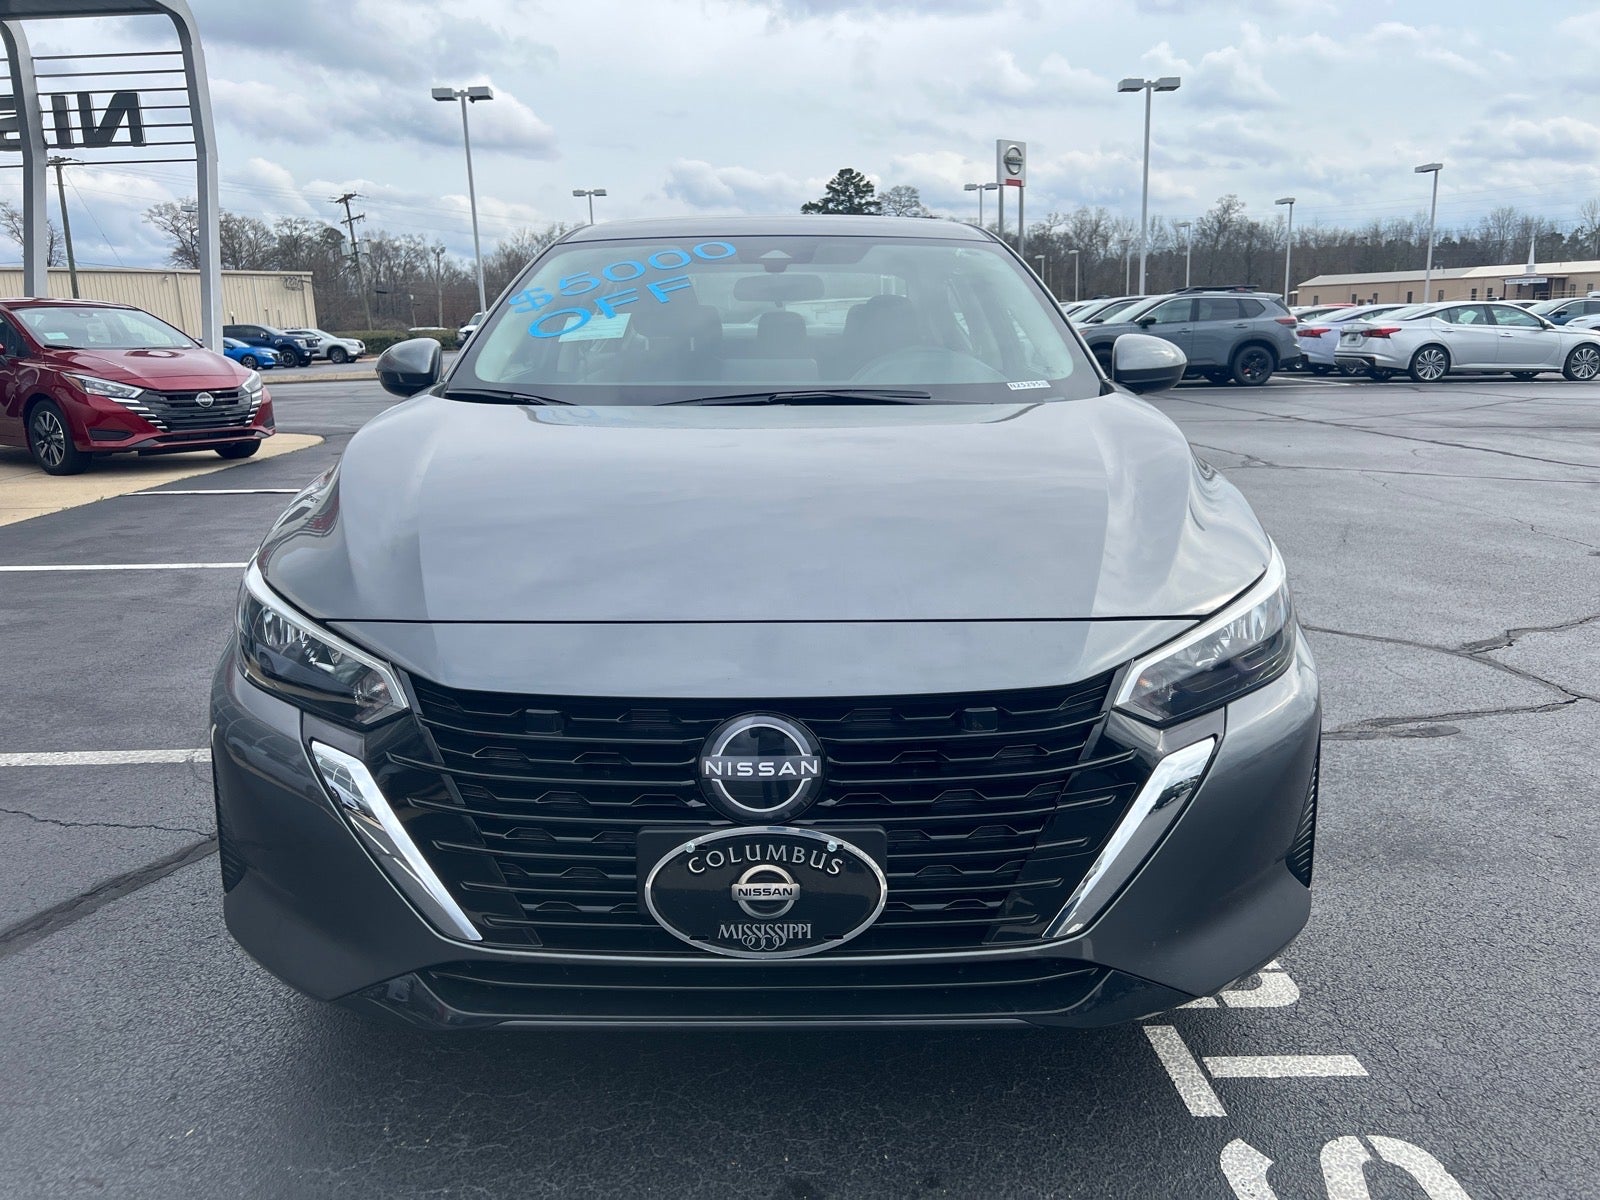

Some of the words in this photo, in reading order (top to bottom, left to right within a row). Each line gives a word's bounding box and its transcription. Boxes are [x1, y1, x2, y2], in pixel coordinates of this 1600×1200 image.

[508, 241, 737, 314] $5000
[528, 274, 692, 338] OFF
[705, 759, 818, 776] NISSAN
[688, 844, 843, 875] COLUMBUS
[737, 886, 793, 897] NISSAN
[718, 923, 812, 951] MISSISSIPPI
